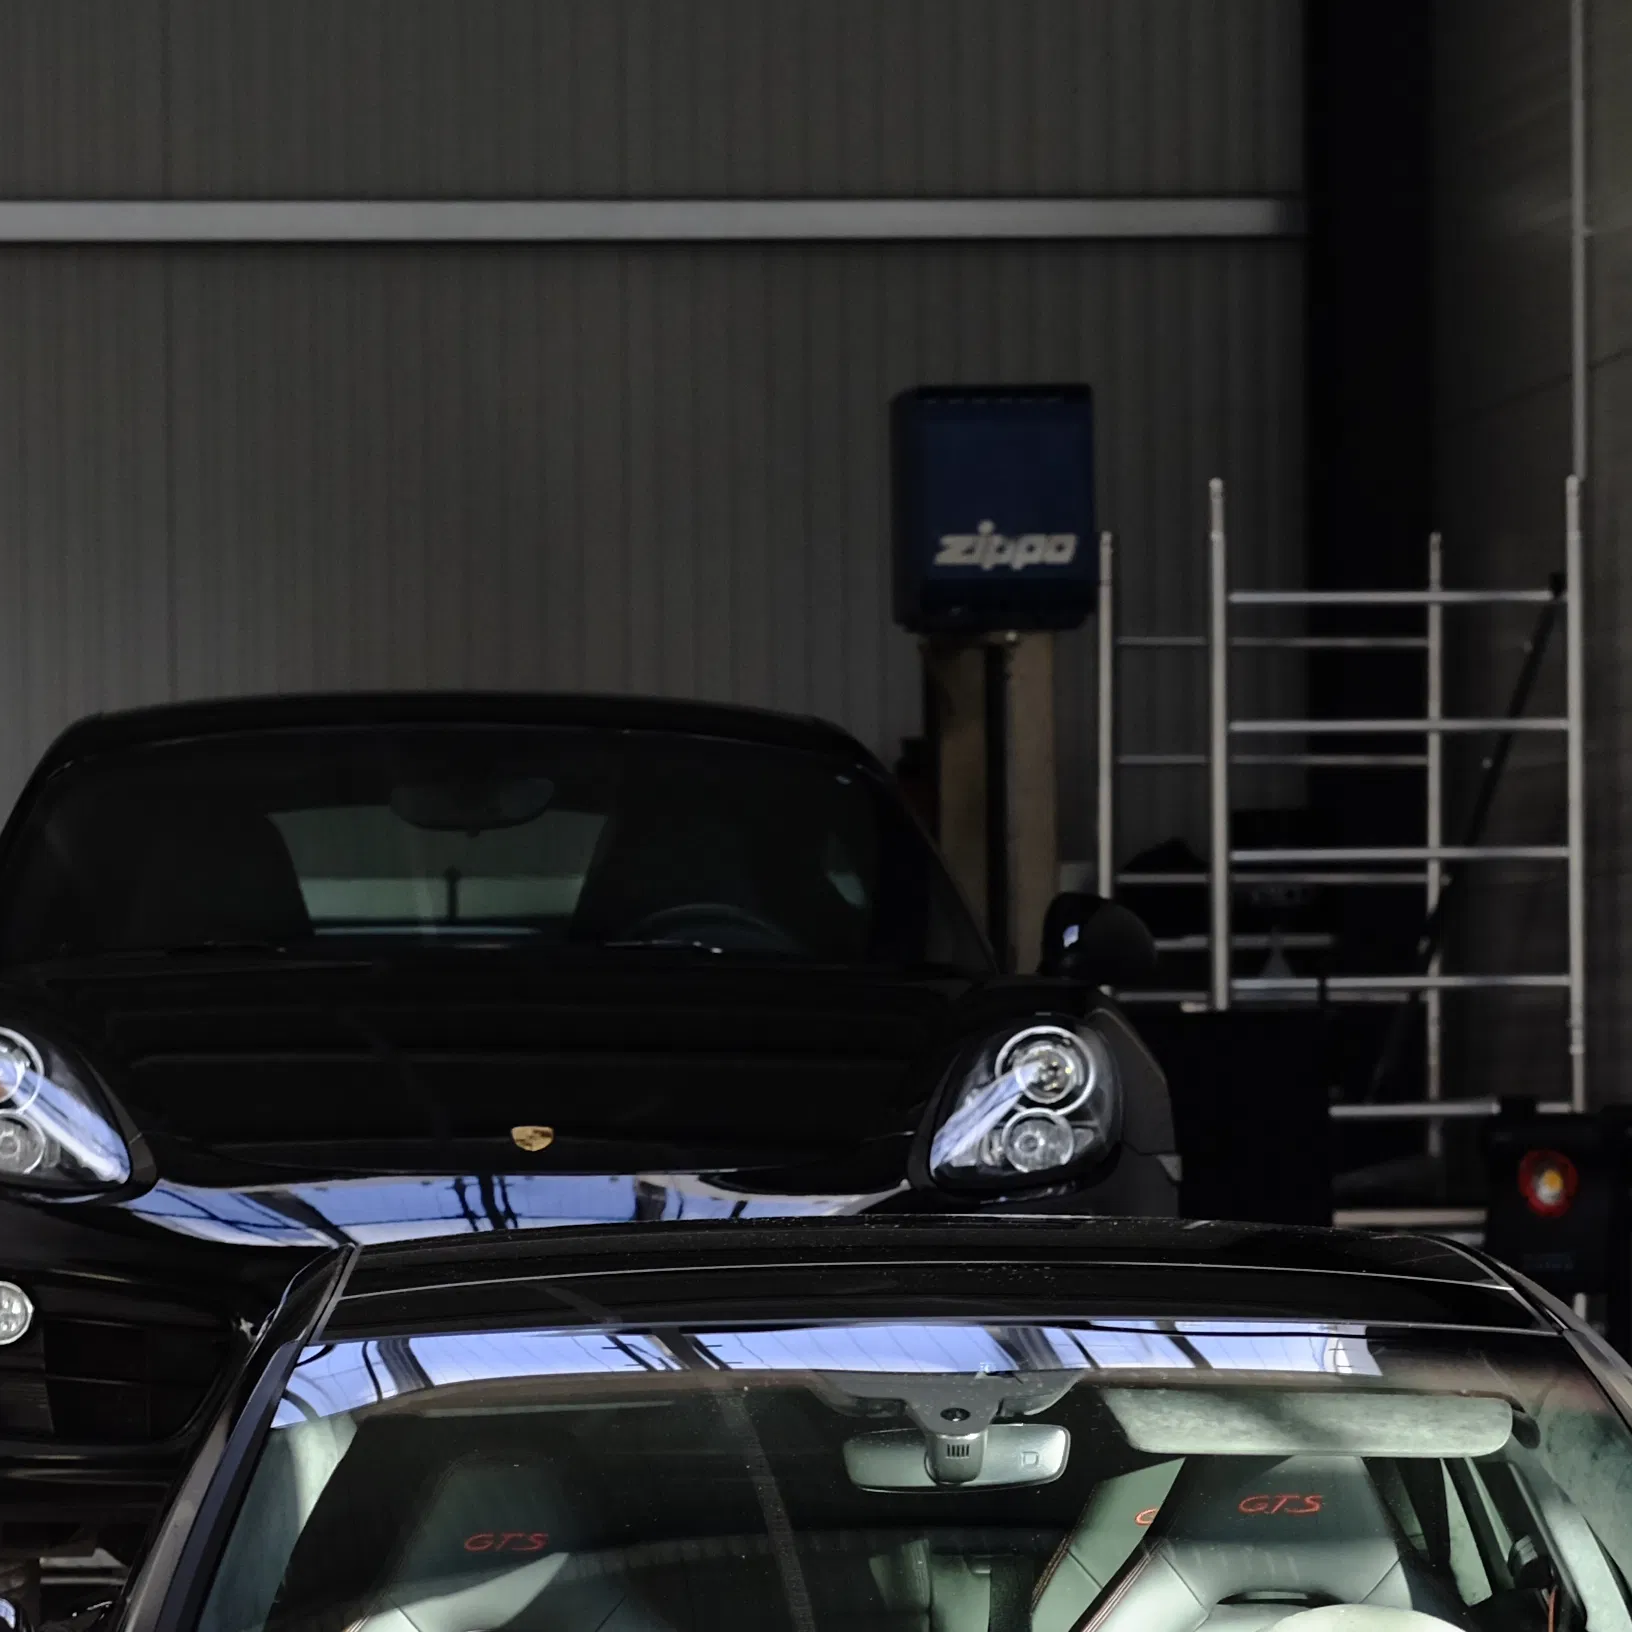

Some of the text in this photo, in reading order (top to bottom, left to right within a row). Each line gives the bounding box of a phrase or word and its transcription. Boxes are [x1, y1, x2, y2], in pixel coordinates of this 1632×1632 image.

[934, 519, 1077, 570] zippo
[1239, 1493, 1325, 1516] GTS
[464, 1532, 549, 1551] GTS
